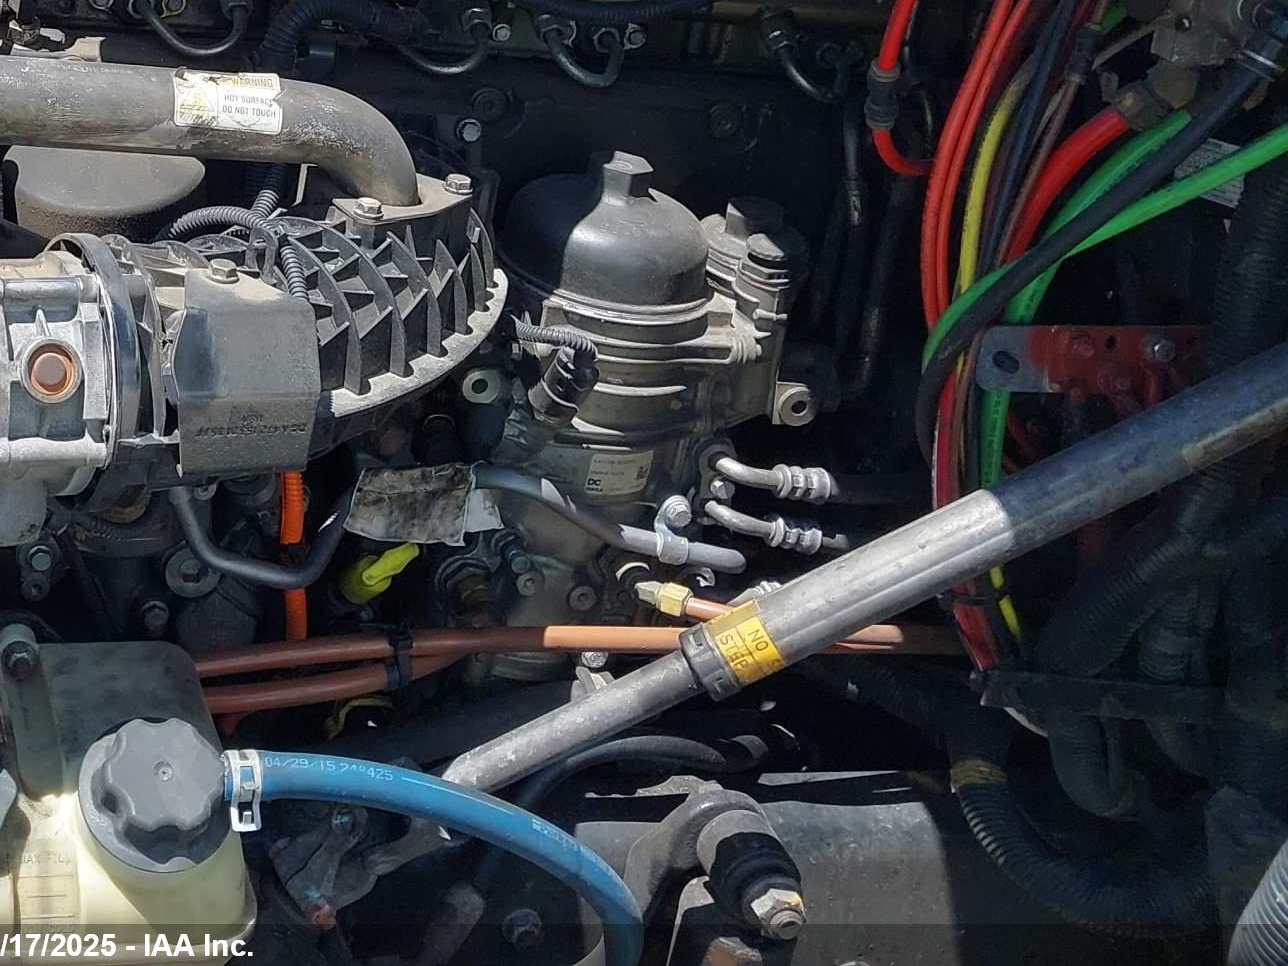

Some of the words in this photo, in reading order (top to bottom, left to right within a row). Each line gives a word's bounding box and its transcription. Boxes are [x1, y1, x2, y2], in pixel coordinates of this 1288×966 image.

[224, 94, 239, 103] HOT
[222, 105, 232, 114] DO
[234, 106, 250, 115] NOT
[252, 107, 276, 118] TOUCH
[587, 478, 602, 487] DC
[748, 628, 769, 652] NO
[264, 756, 336, 772] 04/29/15
